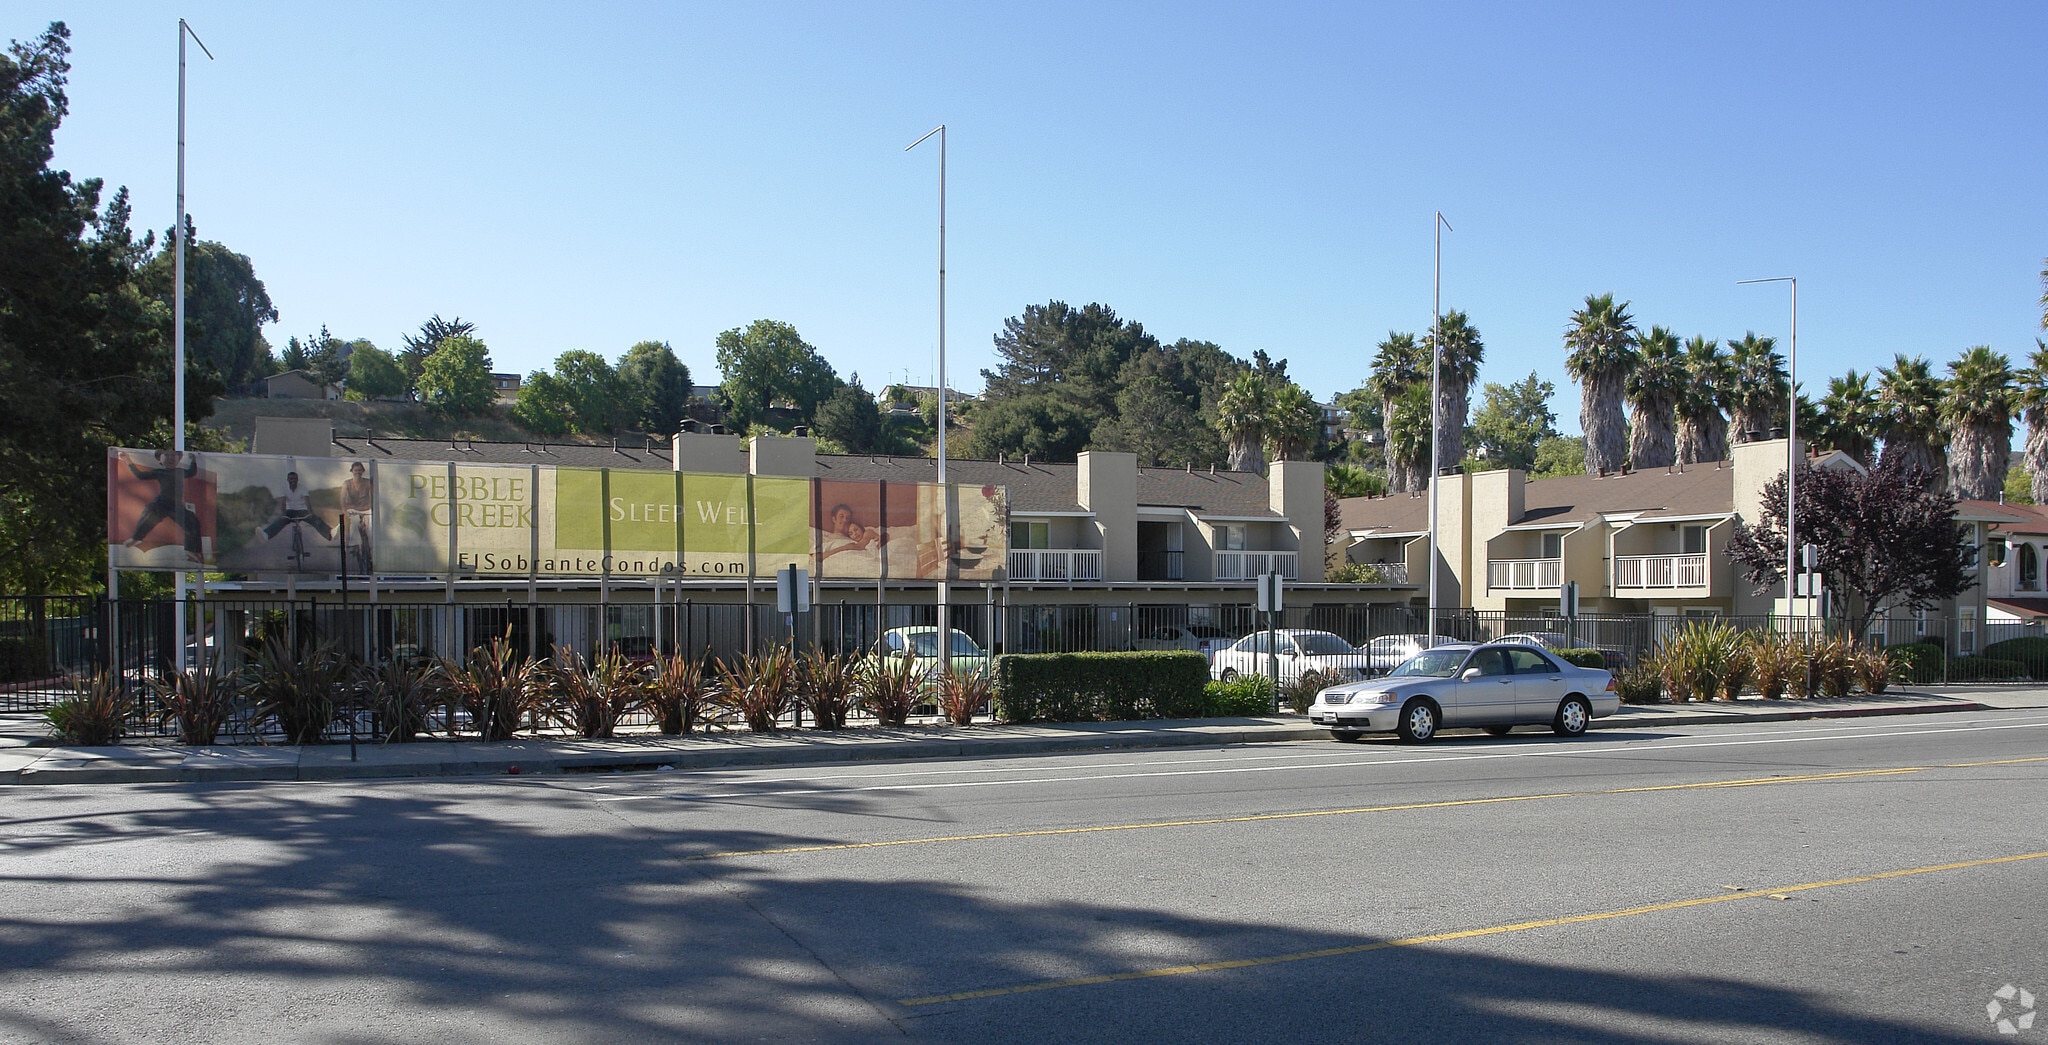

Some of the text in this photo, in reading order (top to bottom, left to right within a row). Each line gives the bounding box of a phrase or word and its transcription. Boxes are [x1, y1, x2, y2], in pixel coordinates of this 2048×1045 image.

[408, 474, 525, 502] PEBBLE
[430, 502, 538, 528] CREEK
[609, 497, 763, 526] SLEEP WELL
[458, 552, 745, 574] ElSobranteCondos.com
